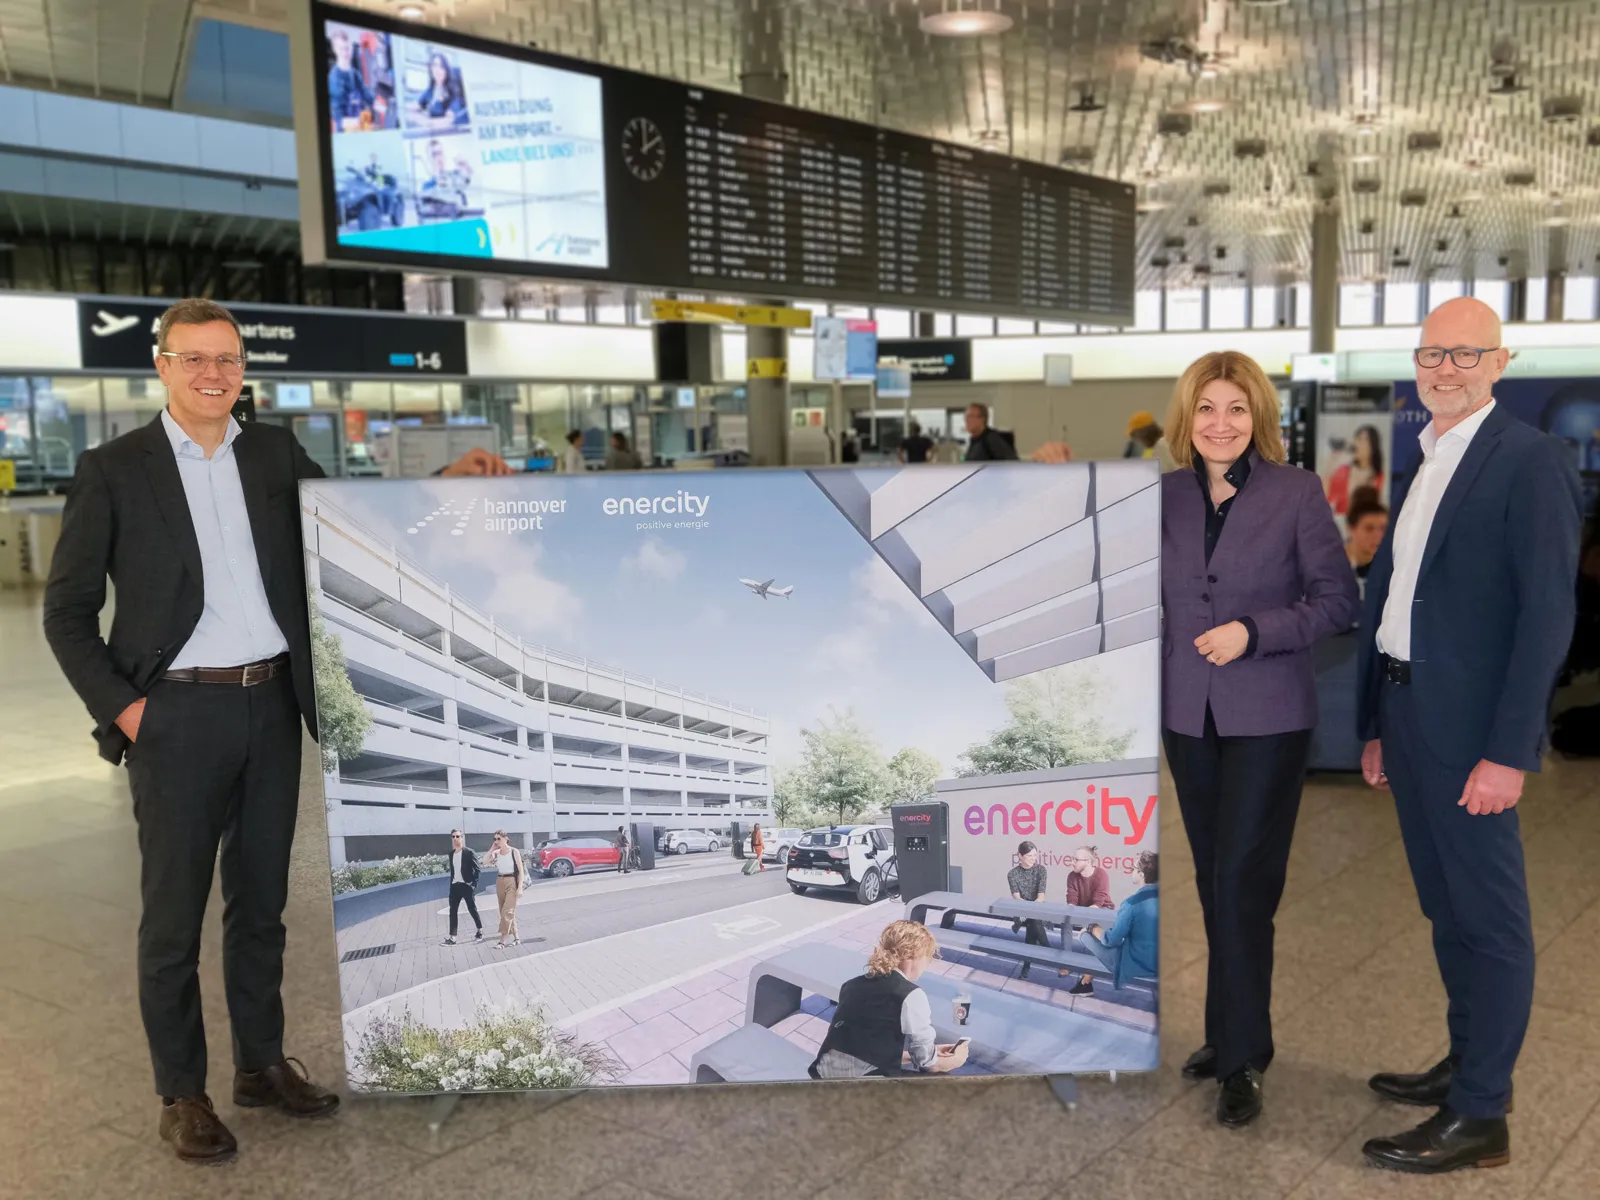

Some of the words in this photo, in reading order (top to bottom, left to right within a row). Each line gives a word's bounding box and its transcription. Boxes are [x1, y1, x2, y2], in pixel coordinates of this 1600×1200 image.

[474, 98, 554, 116] AUSBILDUNG
[751, 360, 760, 375] A
[484, 498, 567, 514] hannover
[602, 490, 710, 517] enercity
[484, 515, 543, 535] airport
[636, 521, 672, 531] positive
[674, 519, 710, 530] energie
[899, 813, 931, 824] enercity
[963, 784, 1159, 846] enercity
[1011, 850, 1074, 867] pitive
